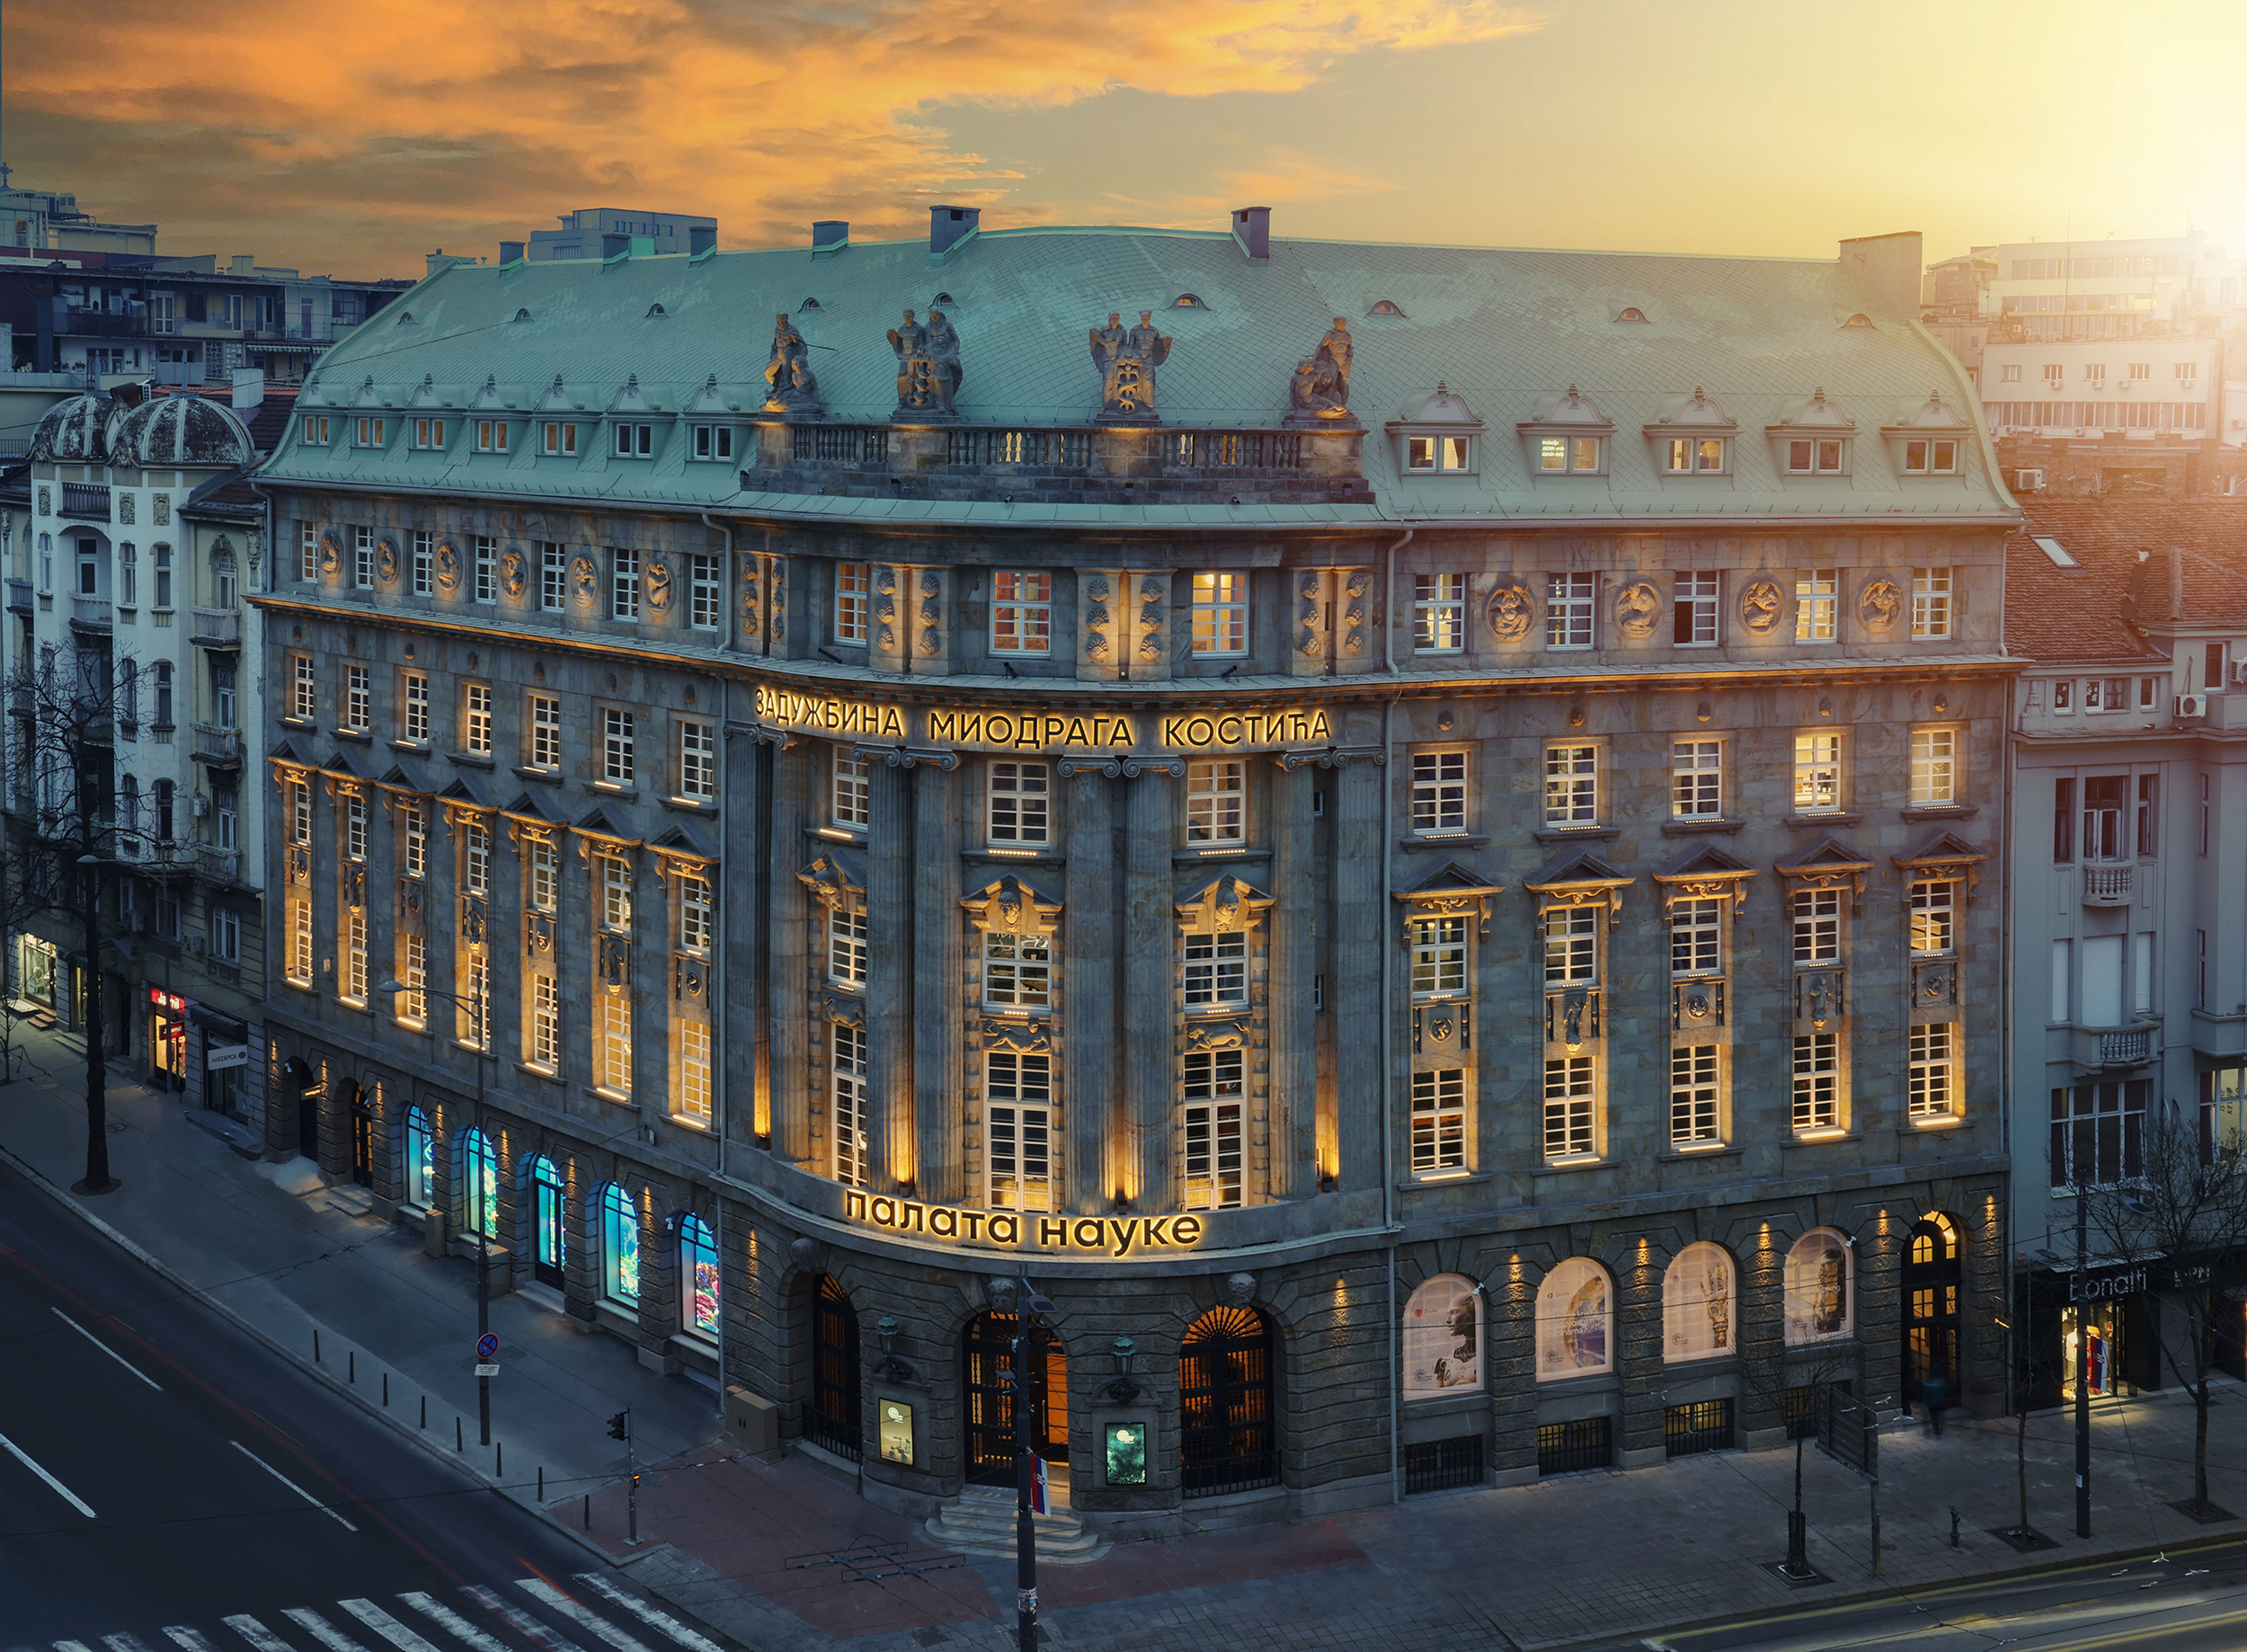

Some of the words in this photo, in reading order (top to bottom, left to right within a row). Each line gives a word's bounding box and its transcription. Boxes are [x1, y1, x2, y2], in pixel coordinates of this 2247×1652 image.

[755, 688, 902, 736] ЗАДУЖБИНА
[929, 712, 1134, 750] МИОДРАГА
[1165, 711, 1331, 747] КОСТИЋА
[211, 1053, 237, 1063] MEDIPOL
[846, 1189, 1019, 1244] палата
[1041, 1215, 1201, 1257] науке
